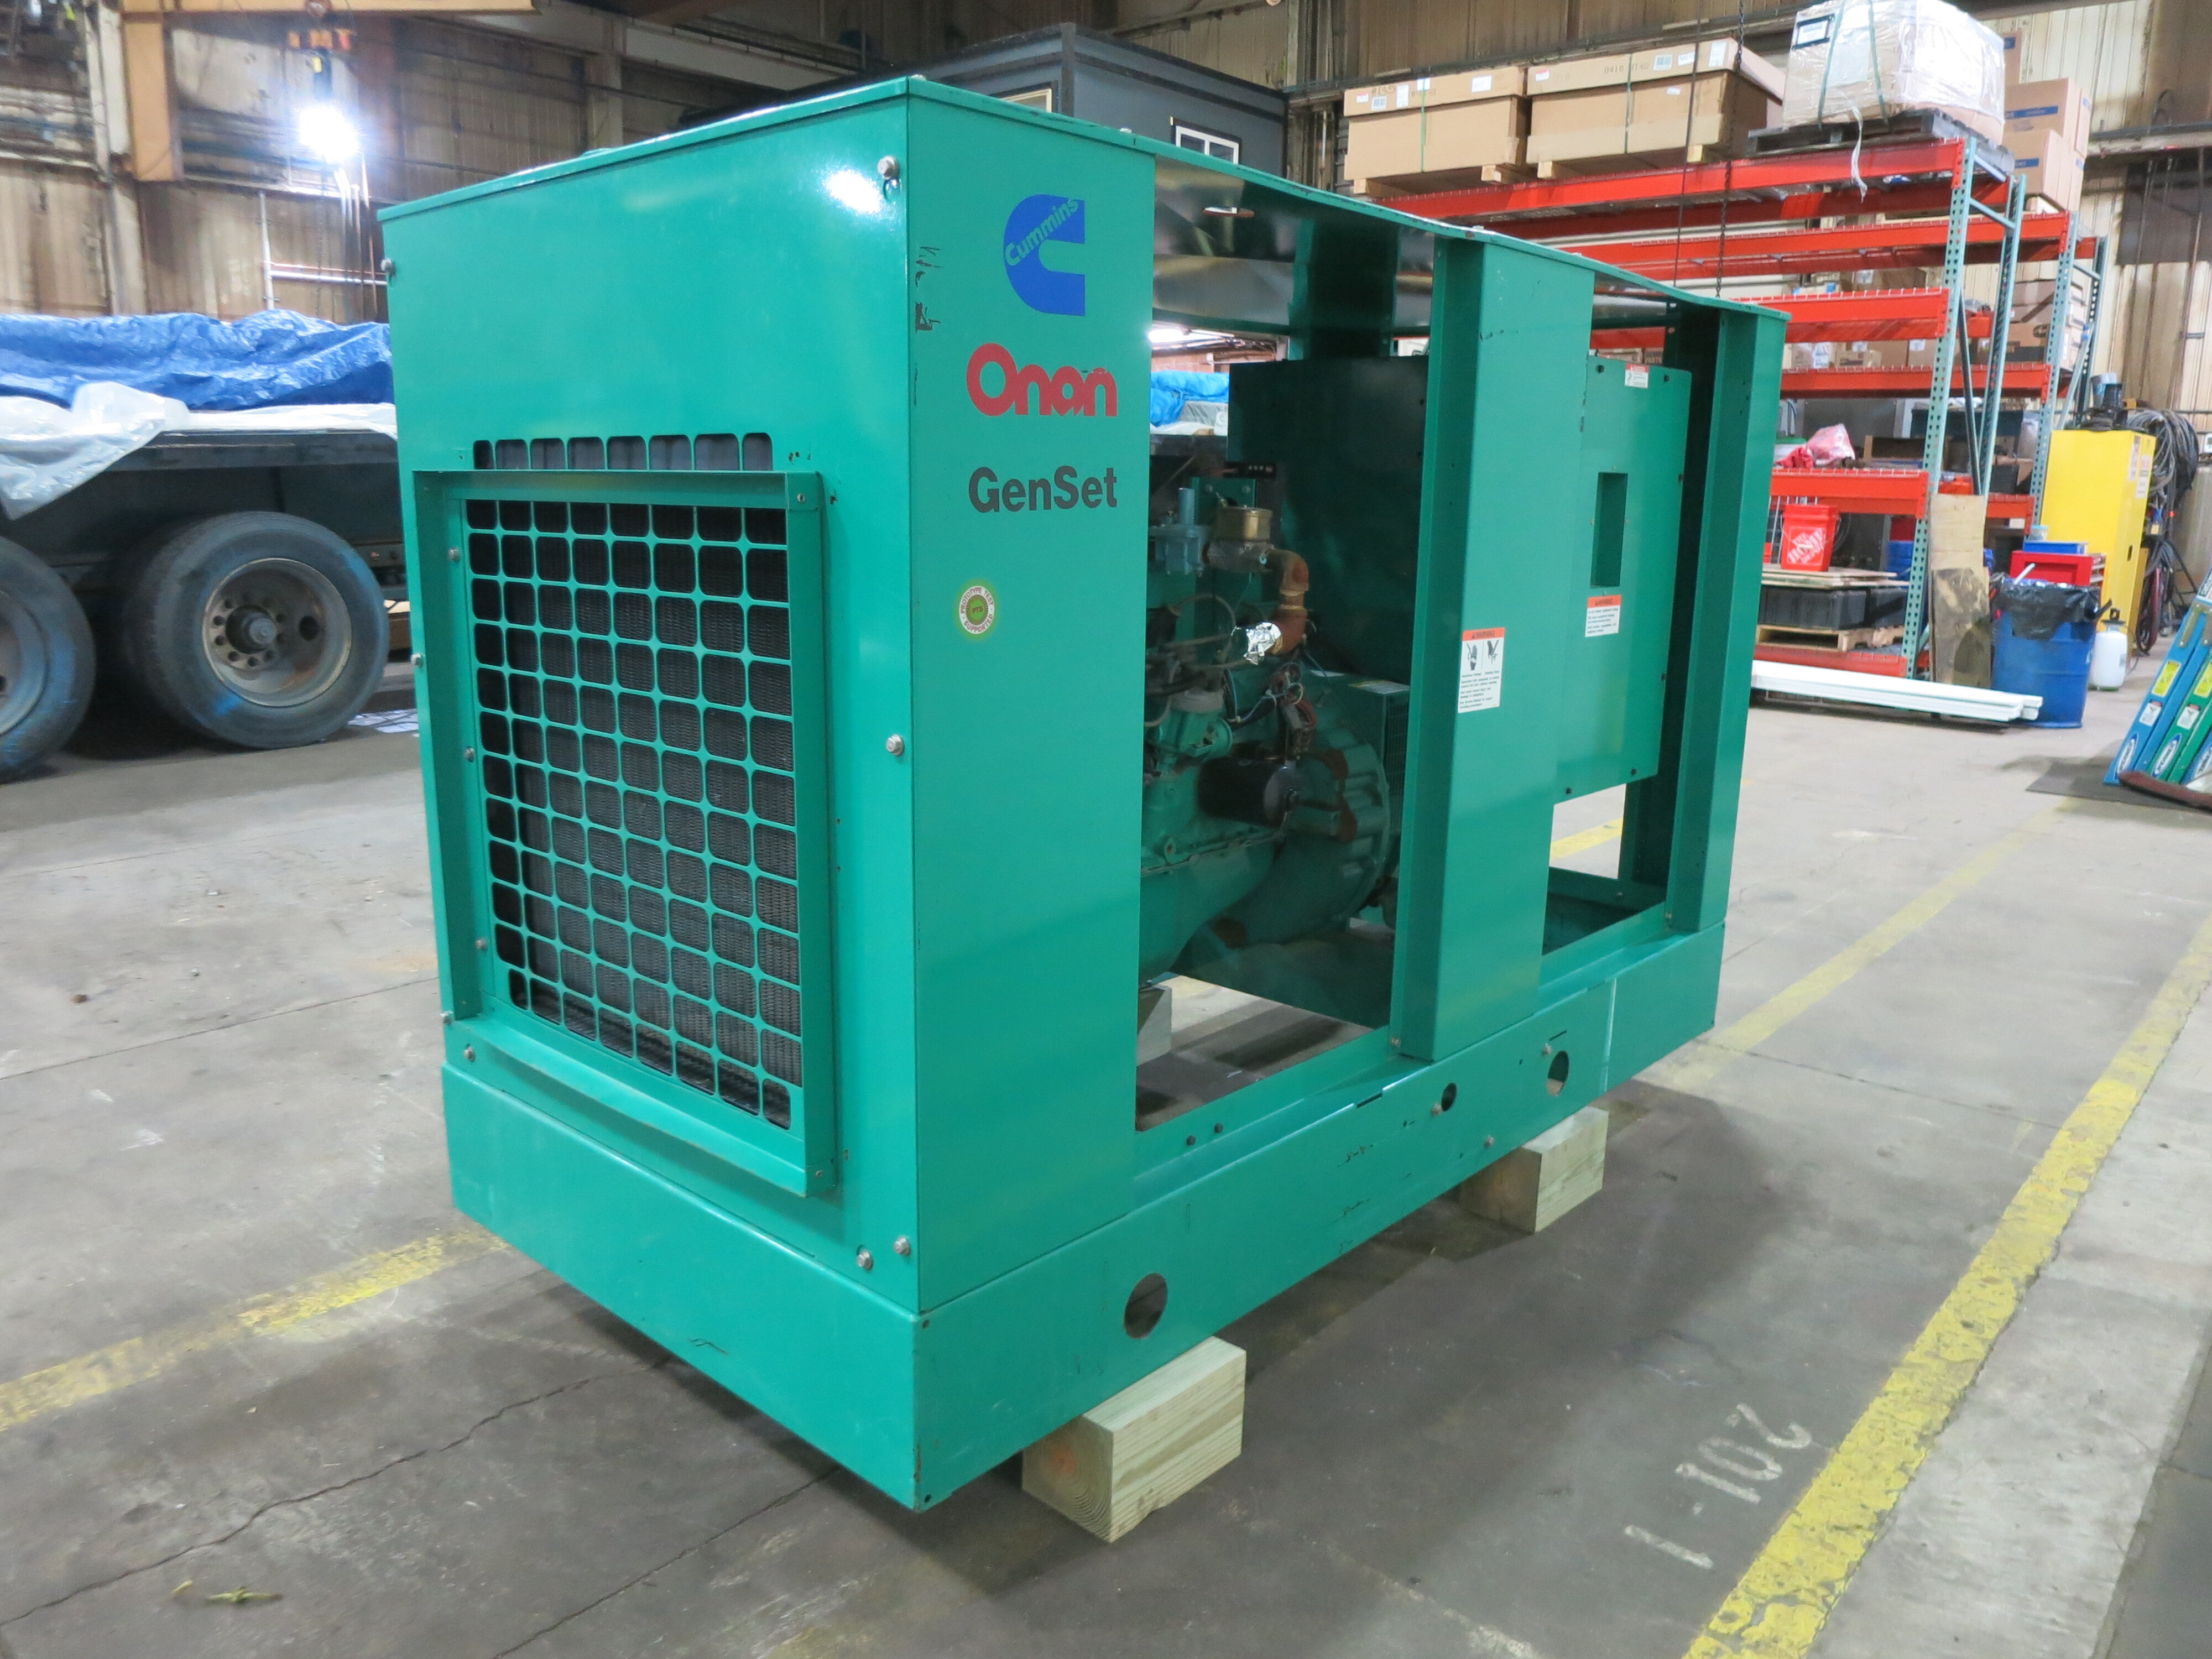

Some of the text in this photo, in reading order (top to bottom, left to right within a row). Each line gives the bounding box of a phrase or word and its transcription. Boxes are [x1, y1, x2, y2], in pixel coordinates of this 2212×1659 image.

[1005, 198, 1079, 266] Cummins
[966, 343, 1118, 416] Onan
[968, 465, 1118, 513] GenSet
[961, 587, 994, 614] PROTOTYPE TEST
[964, 613, 993, 633] SUPPORTED
